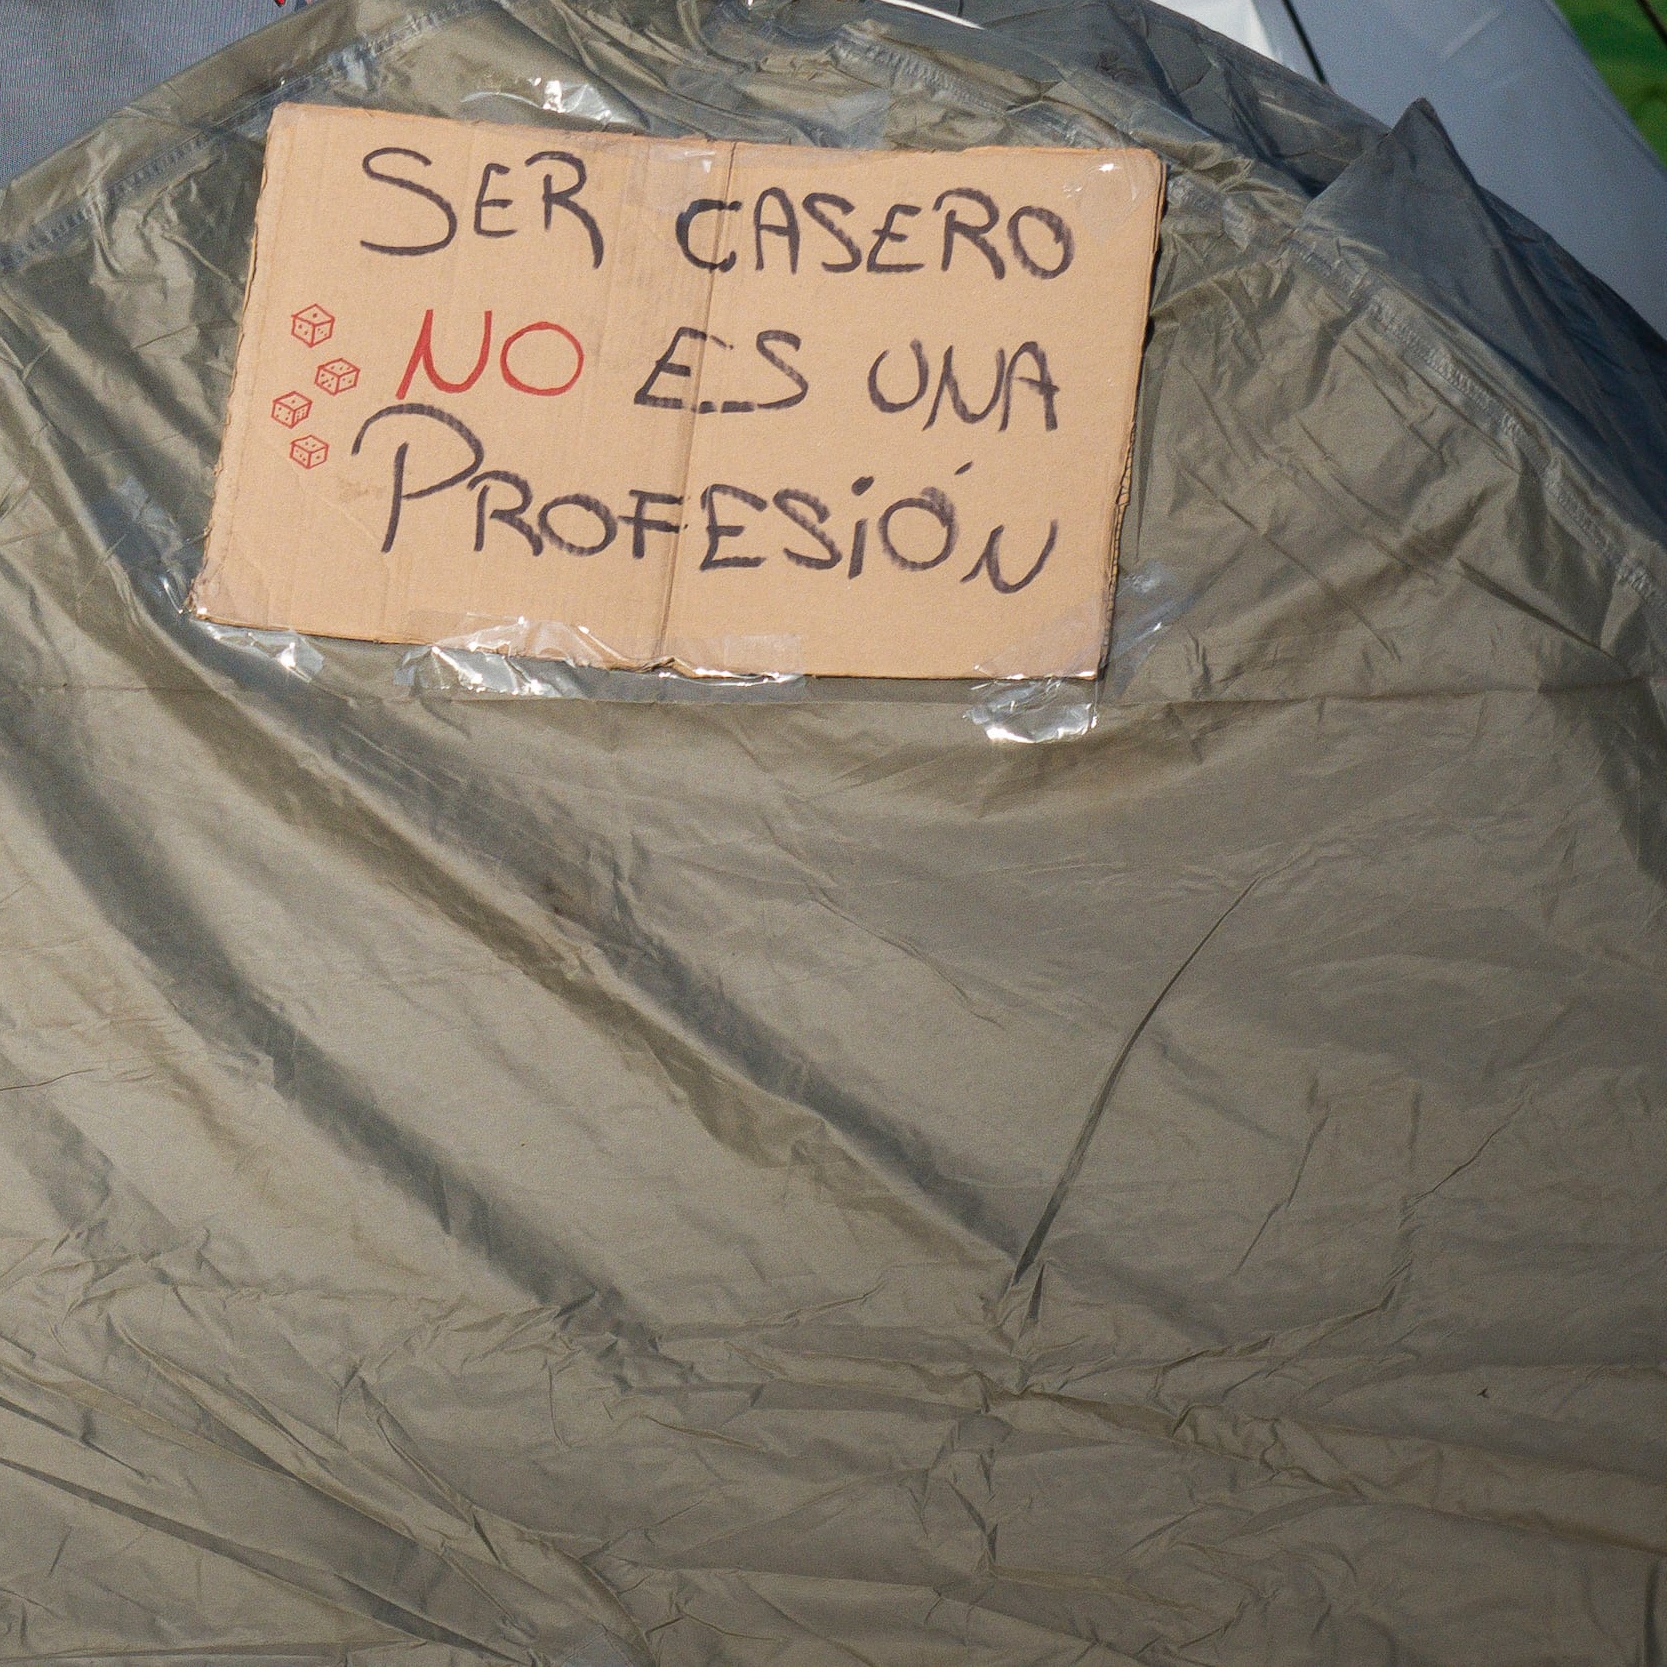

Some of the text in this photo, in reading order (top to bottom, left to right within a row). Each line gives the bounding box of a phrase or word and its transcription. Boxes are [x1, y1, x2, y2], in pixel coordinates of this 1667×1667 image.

[359, 145, 1075, 281] SER CASERO
[394, 308, 1062, 433] NO ES UNA
